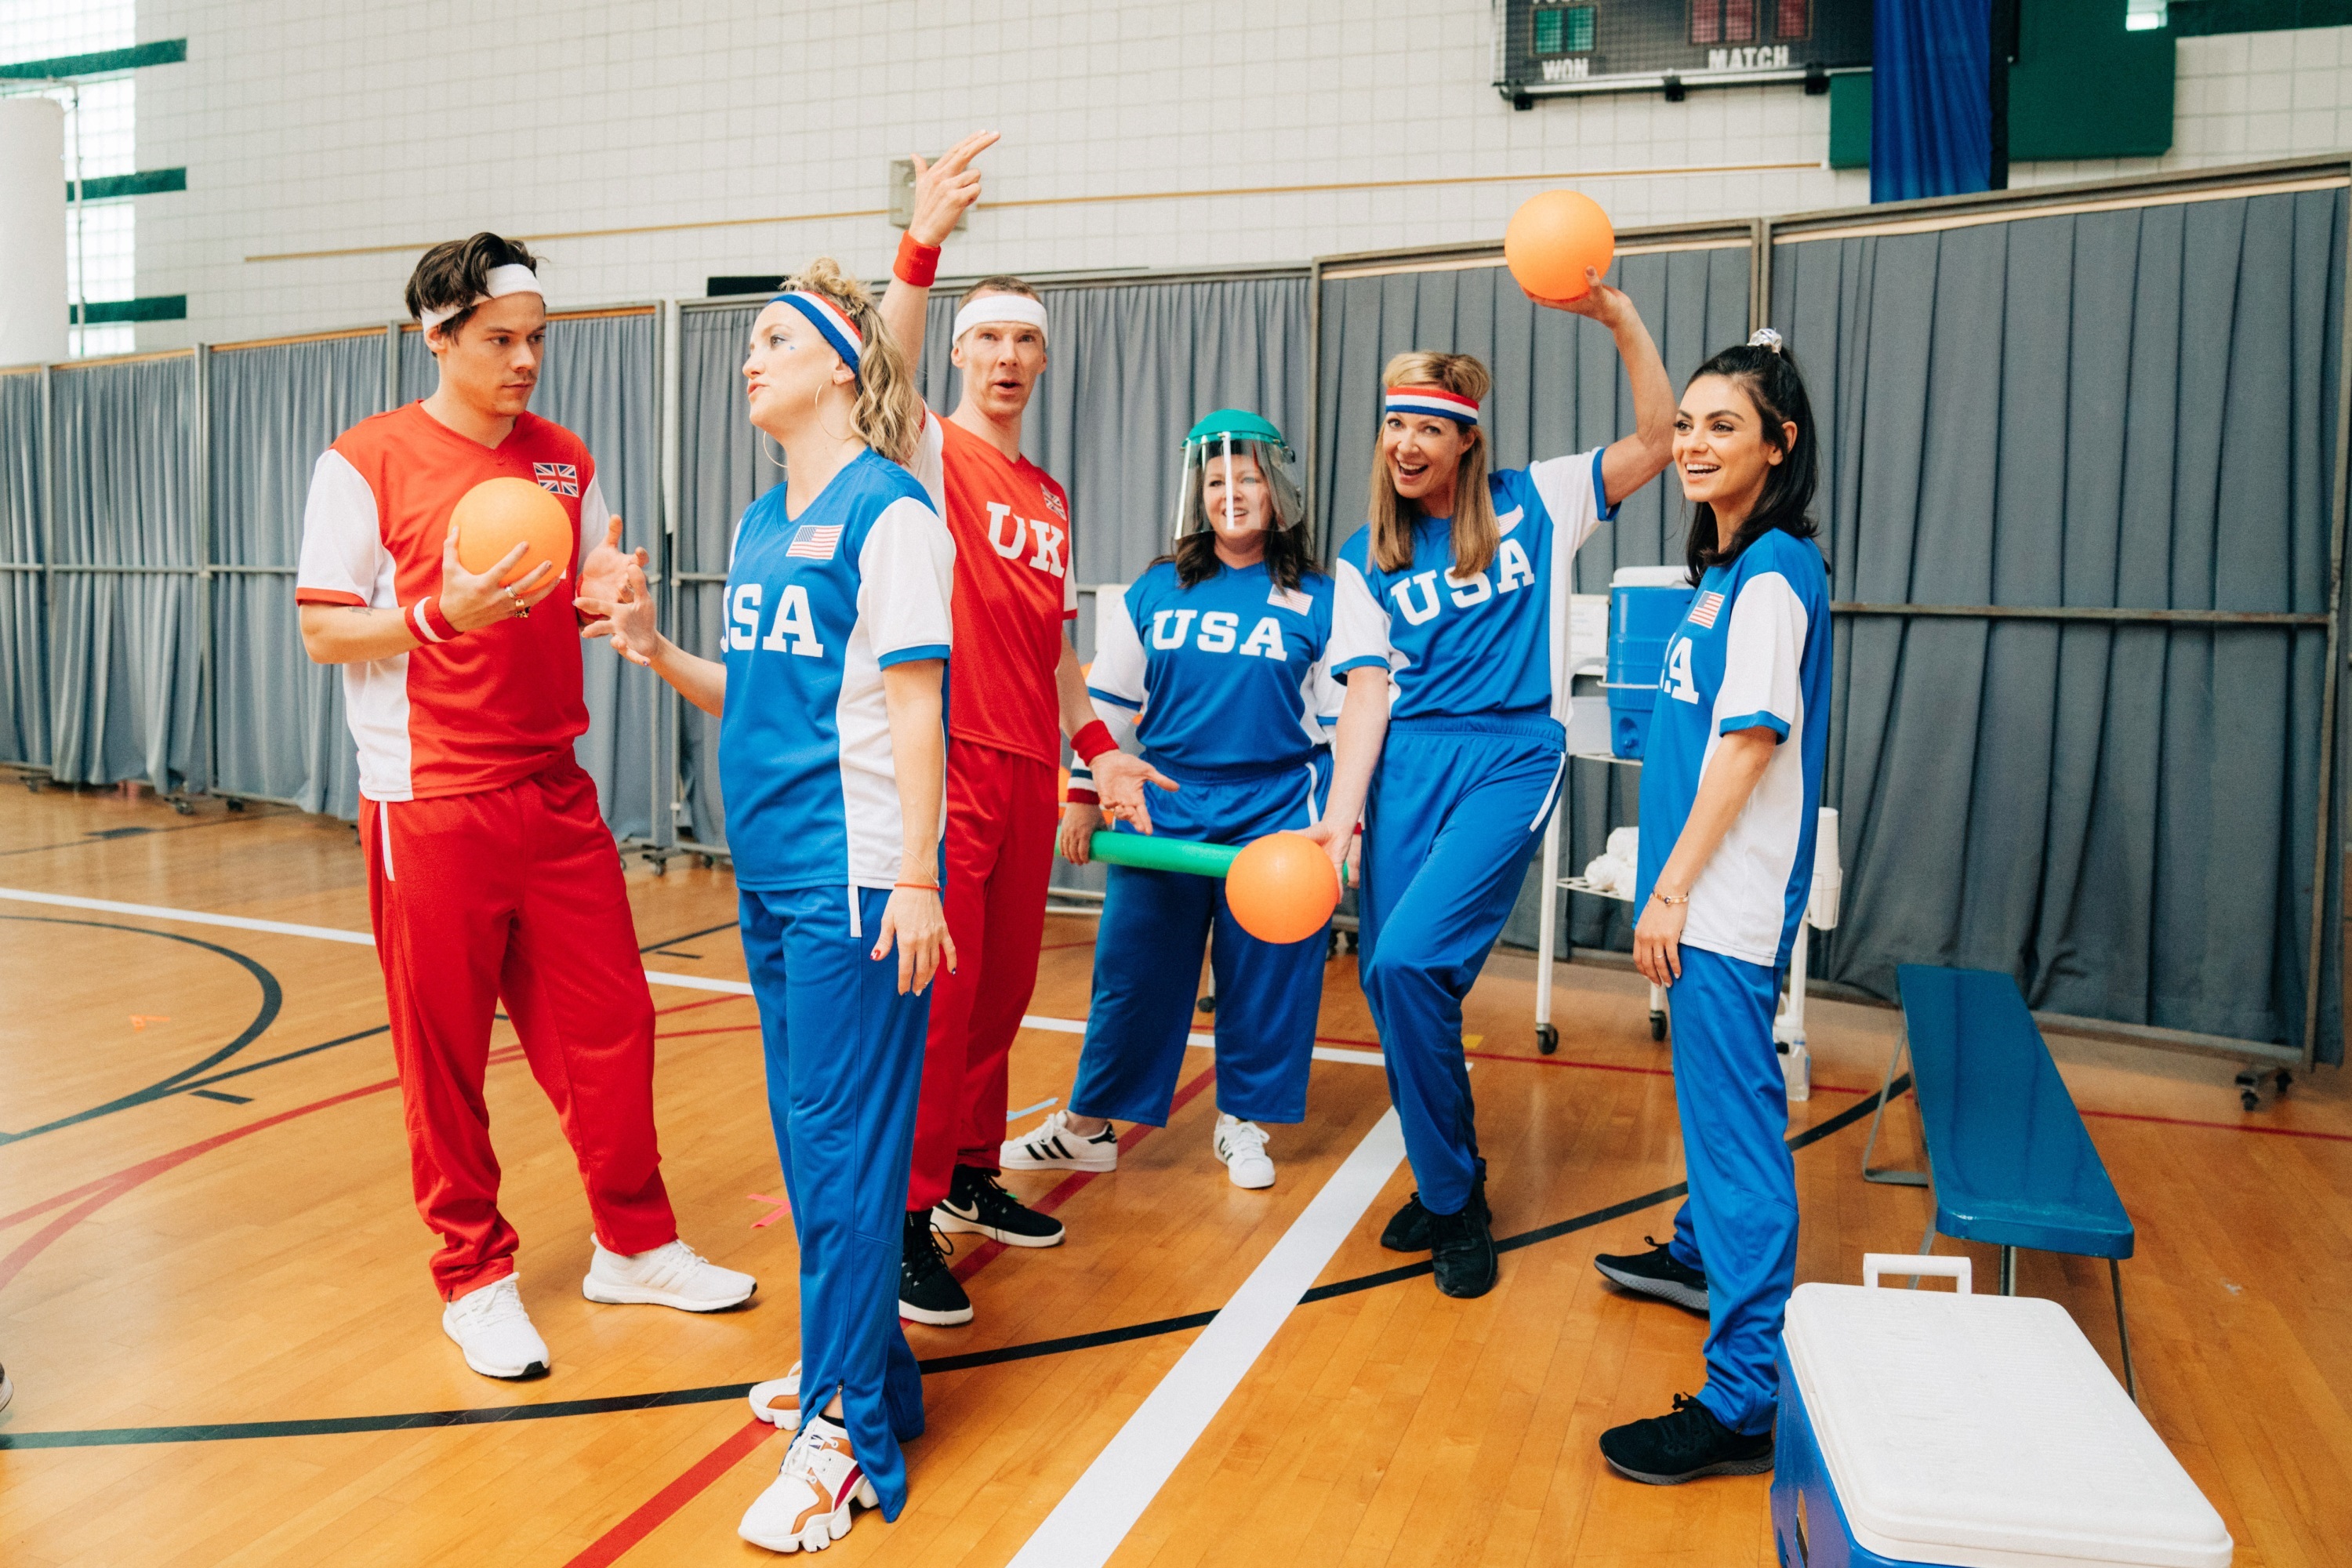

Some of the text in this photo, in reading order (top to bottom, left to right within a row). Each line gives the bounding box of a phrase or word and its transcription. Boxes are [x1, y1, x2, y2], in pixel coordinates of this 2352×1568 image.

[1541, 57, 1589, 81] WON
[1708, 45, 1789, 71] MATCH
[986, 501, 1065, 579] UK
[1391, 538, 1535, 626] USA
[1152, 609, 1287, 662] USA
